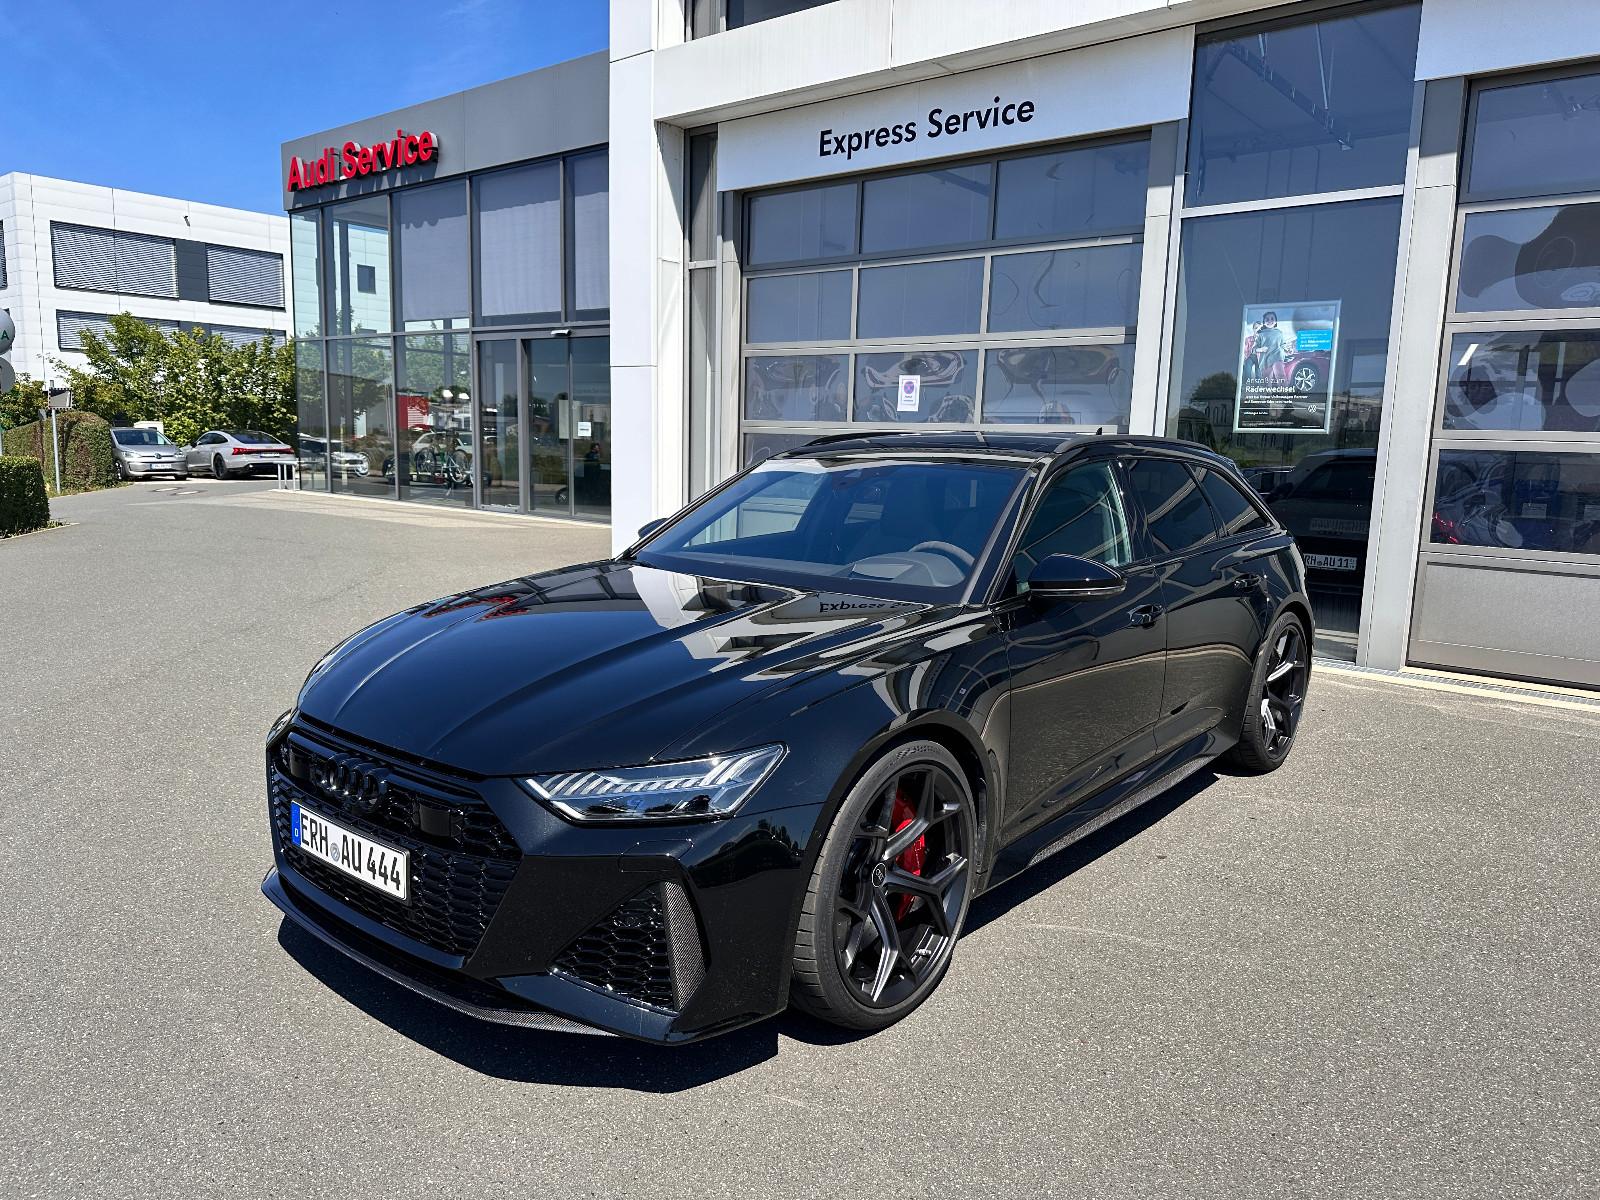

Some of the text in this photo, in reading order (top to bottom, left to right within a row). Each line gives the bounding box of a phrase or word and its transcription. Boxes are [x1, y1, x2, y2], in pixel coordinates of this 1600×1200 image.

[819, 95, 1035, 160] Express Service
[287, 129, 437, 192] Audi Service
[1245, 385, 1296, 393] Räderwechsel
[1304, 555, 1317, 566] RH
[1323, 556, 1336, 567] AU
[300, 812, 401, 891] ERH AU 444
